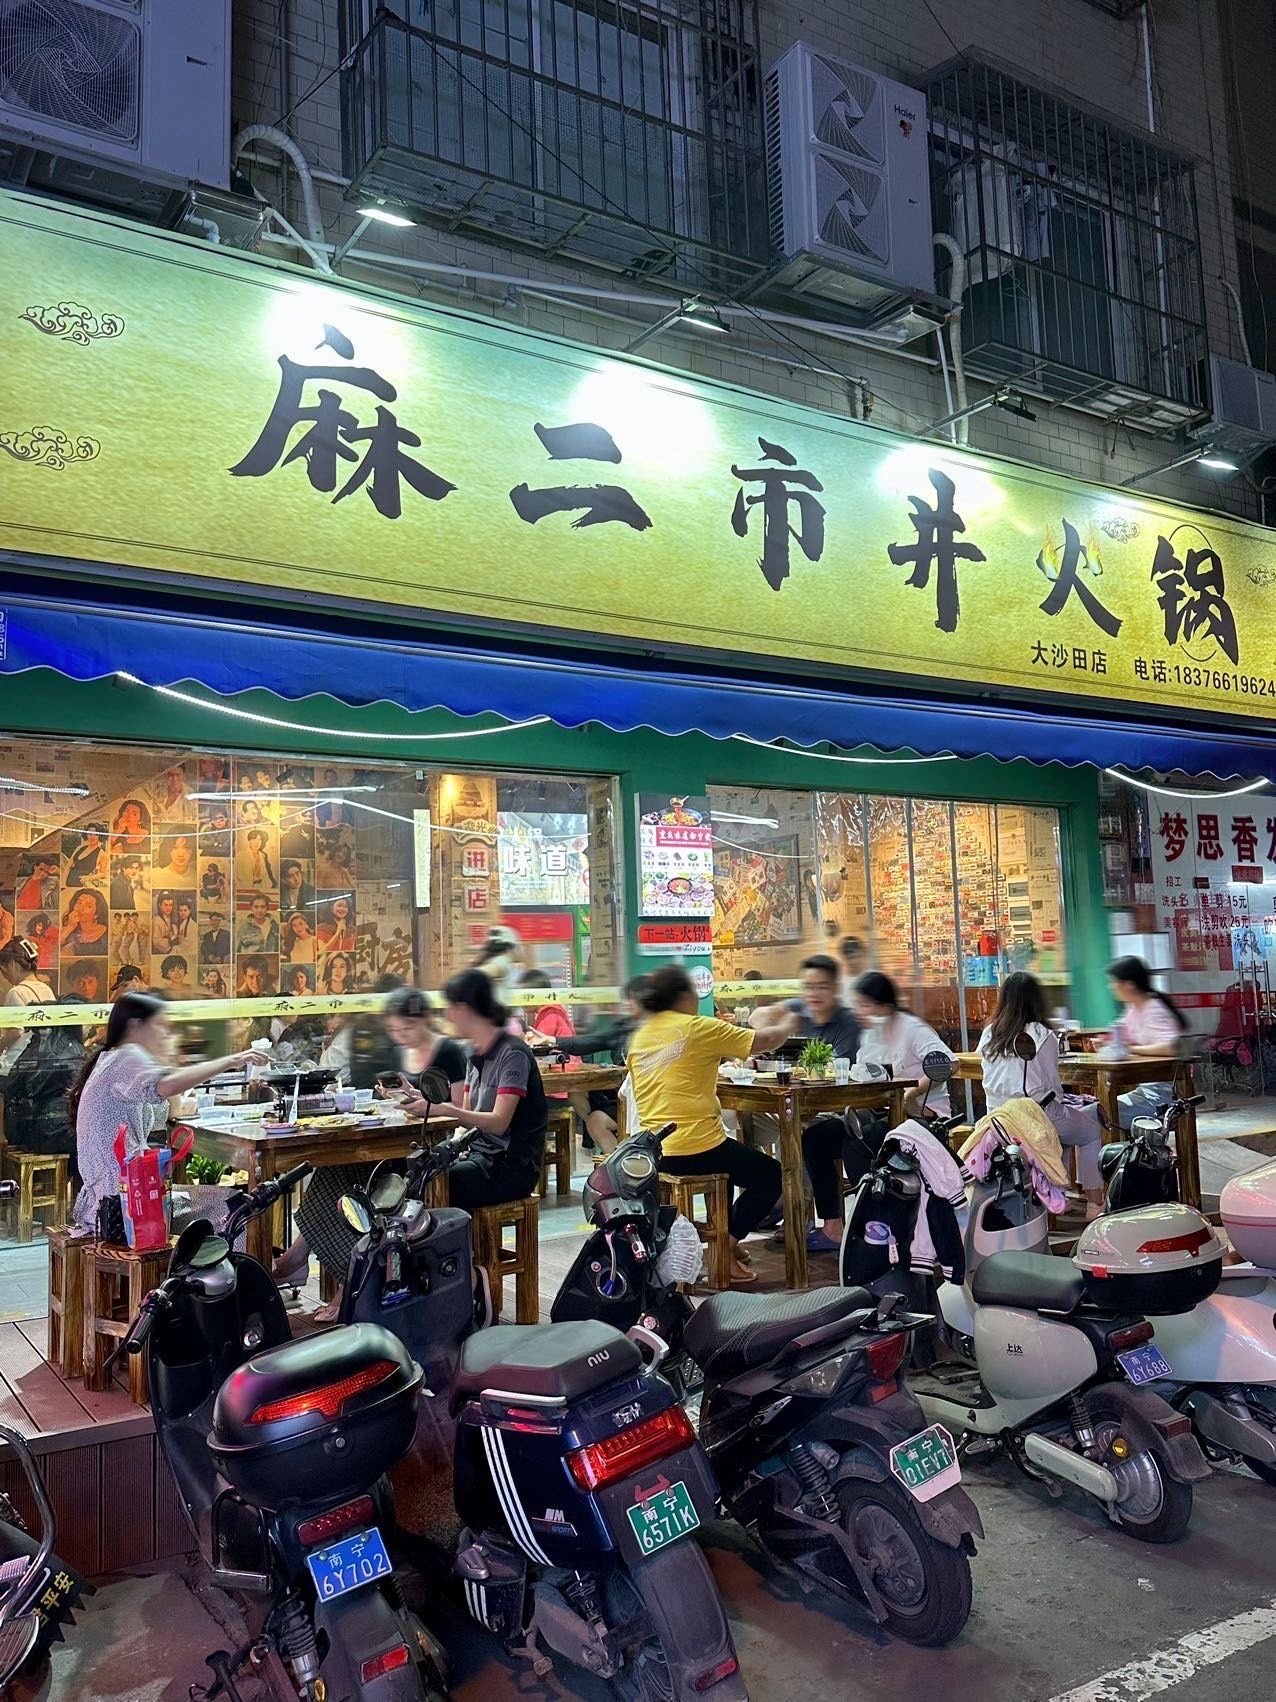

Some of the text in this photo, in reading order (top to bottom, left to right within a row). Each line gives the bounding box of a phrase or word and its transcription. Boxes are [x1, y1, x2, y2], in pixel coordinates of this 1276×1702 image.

[894, 104, 917, 120] Haier
[231, 325, 1239, 666] 麻二市井火锅
[1031, 640, 1107, 674] 大沙田店
[503, 844, 568, 877] 味道
[1166, 876, 1182, 887] 招工
[1130, 1352, 1151, 1365] 南宁
[1132, 1360, 1168, 1381] 6Y688
[905, 1440, 933, 1462] 南宁
[641, 1495, 678, 1524] 南宁
[642, 1505, 695, 1549] 6571K
[327, 1543, 365, 1568] 南宁
[323, 1553, 387, 1596] 6Y702
